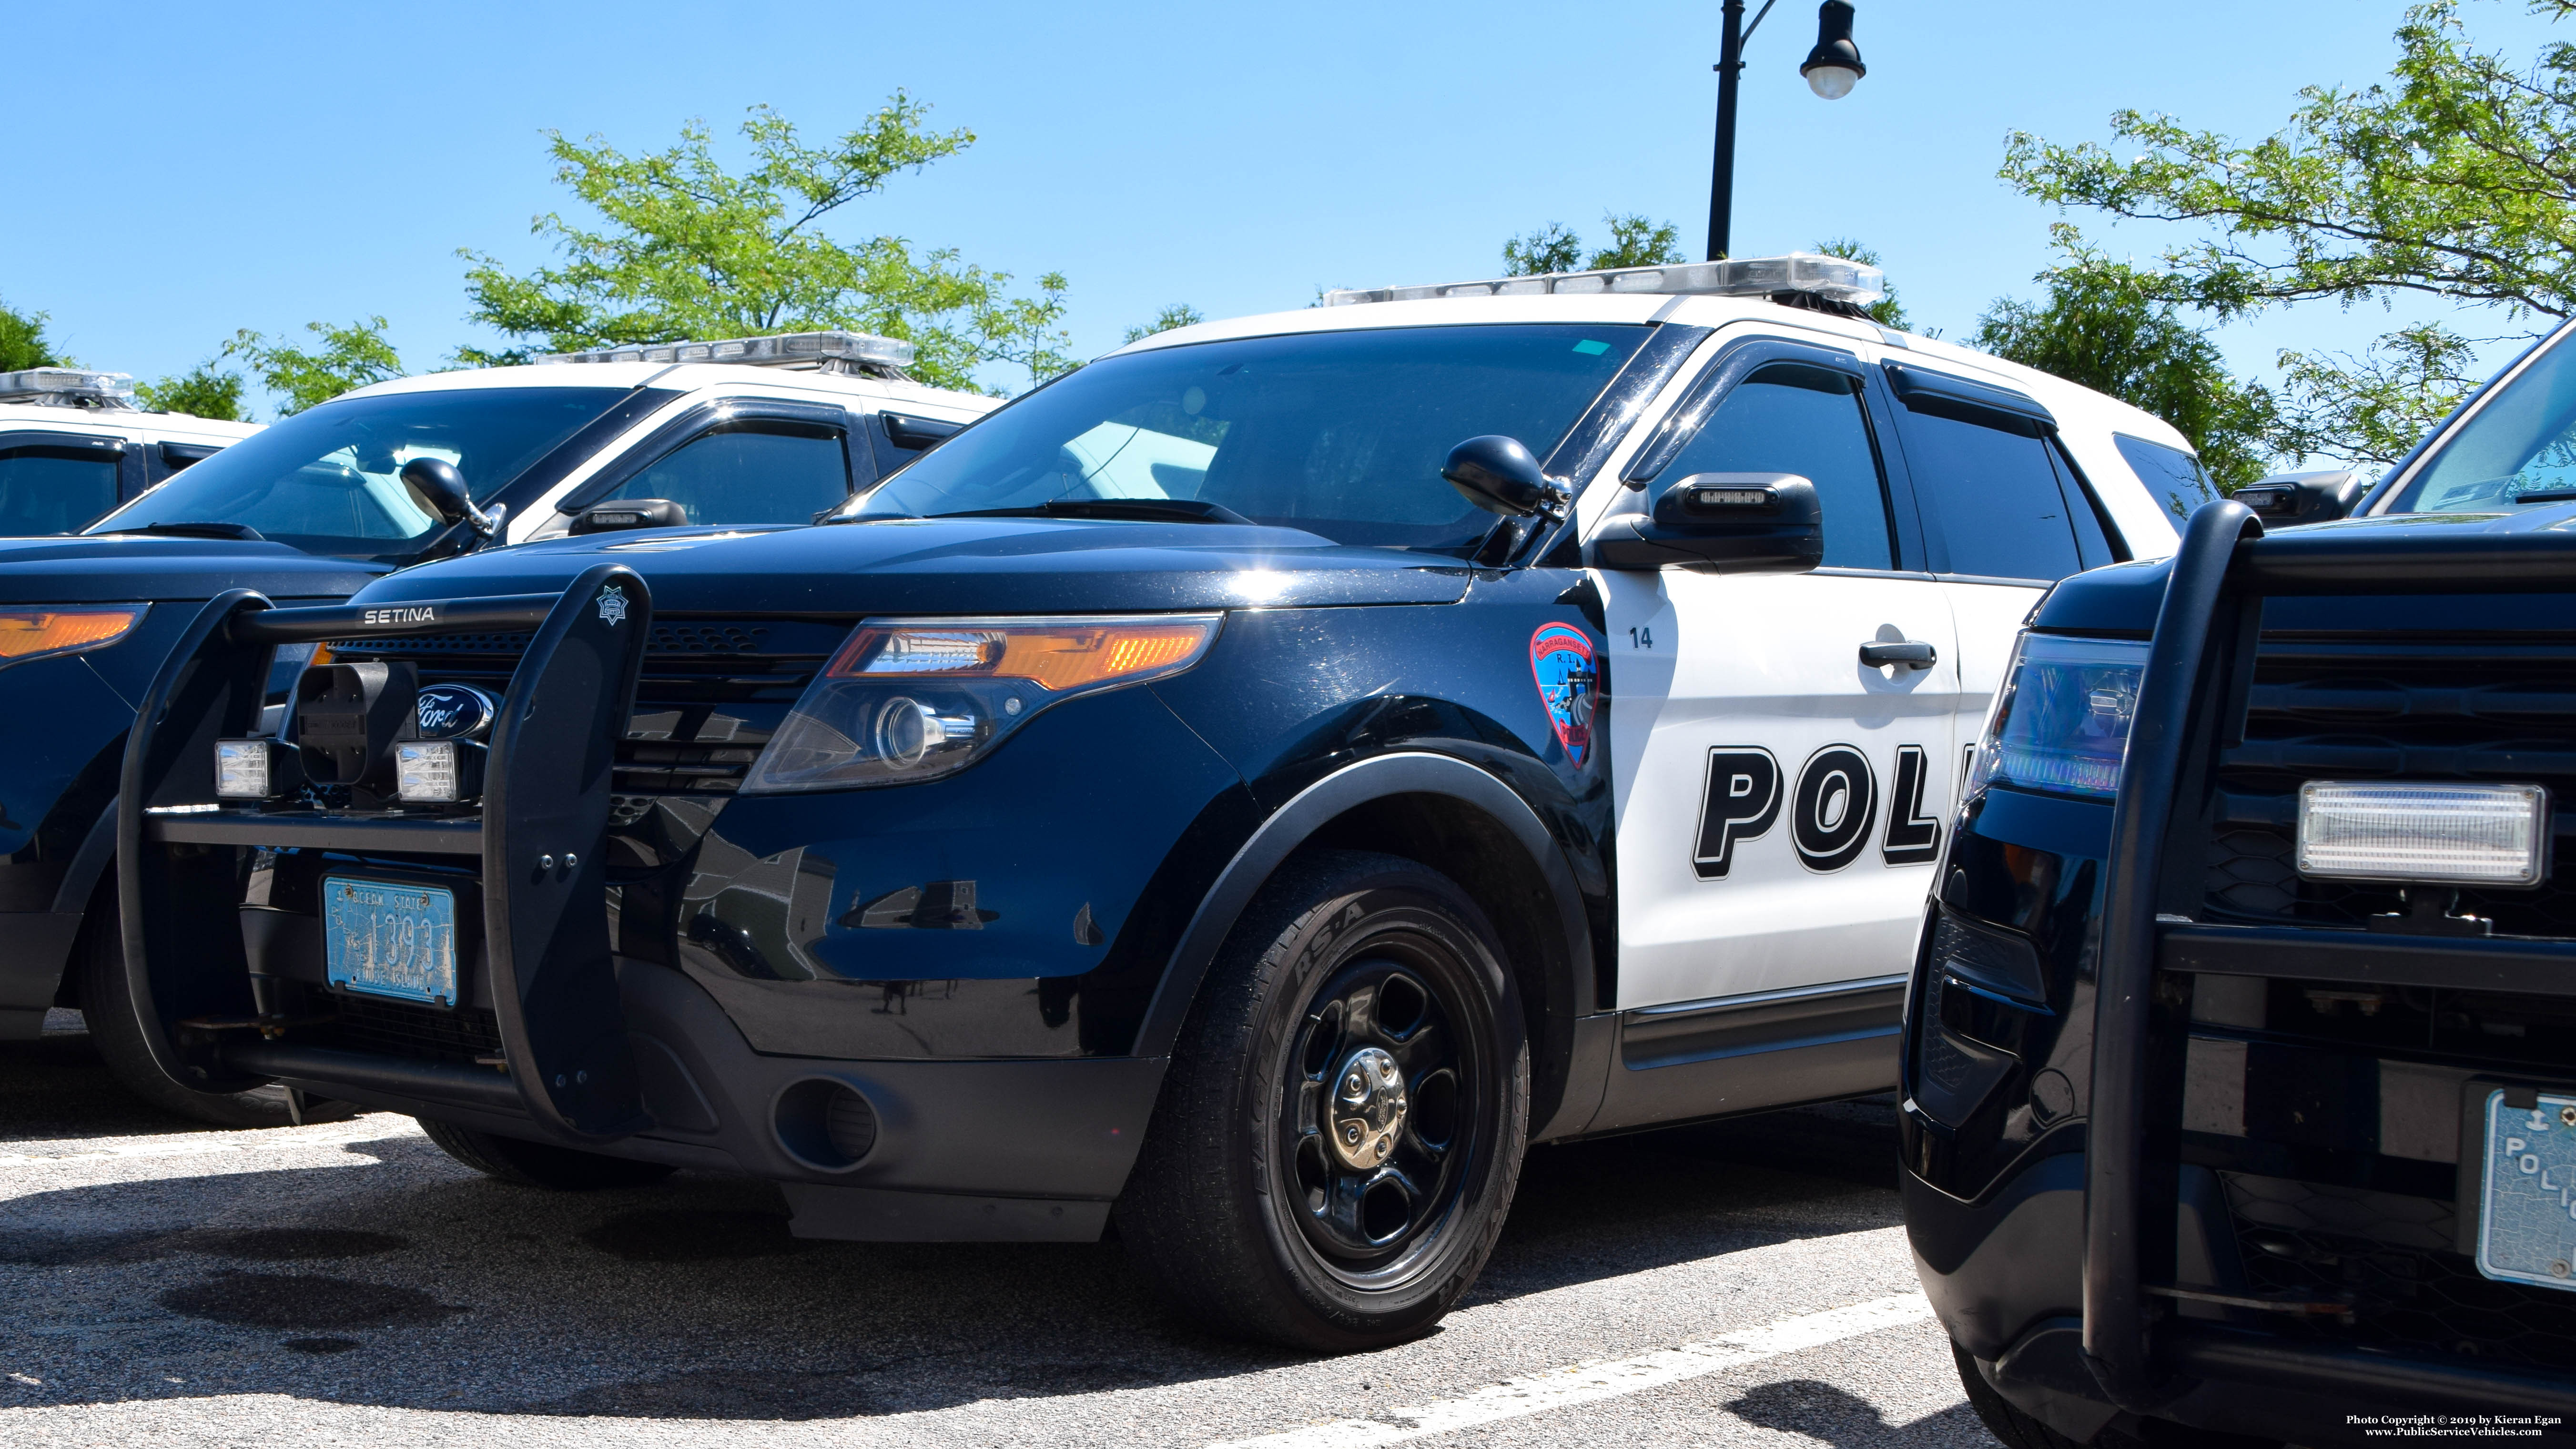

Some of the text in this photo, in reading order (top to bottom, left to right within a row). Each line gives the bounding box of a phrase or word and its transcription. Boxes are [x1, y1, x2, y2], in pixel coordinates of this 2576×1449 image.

[365, 608, 434, 624] SETINA
[1538, 638, 1590, 657] NARRAGANSETT
[1630, 627, 1653, 649] 14
[418, 693, 464, 728] Ford
[1690, 742, 1976, 882] POL
[353, 891, 383, 906] OCEAN
[370, 913, 433, 971] 1393
